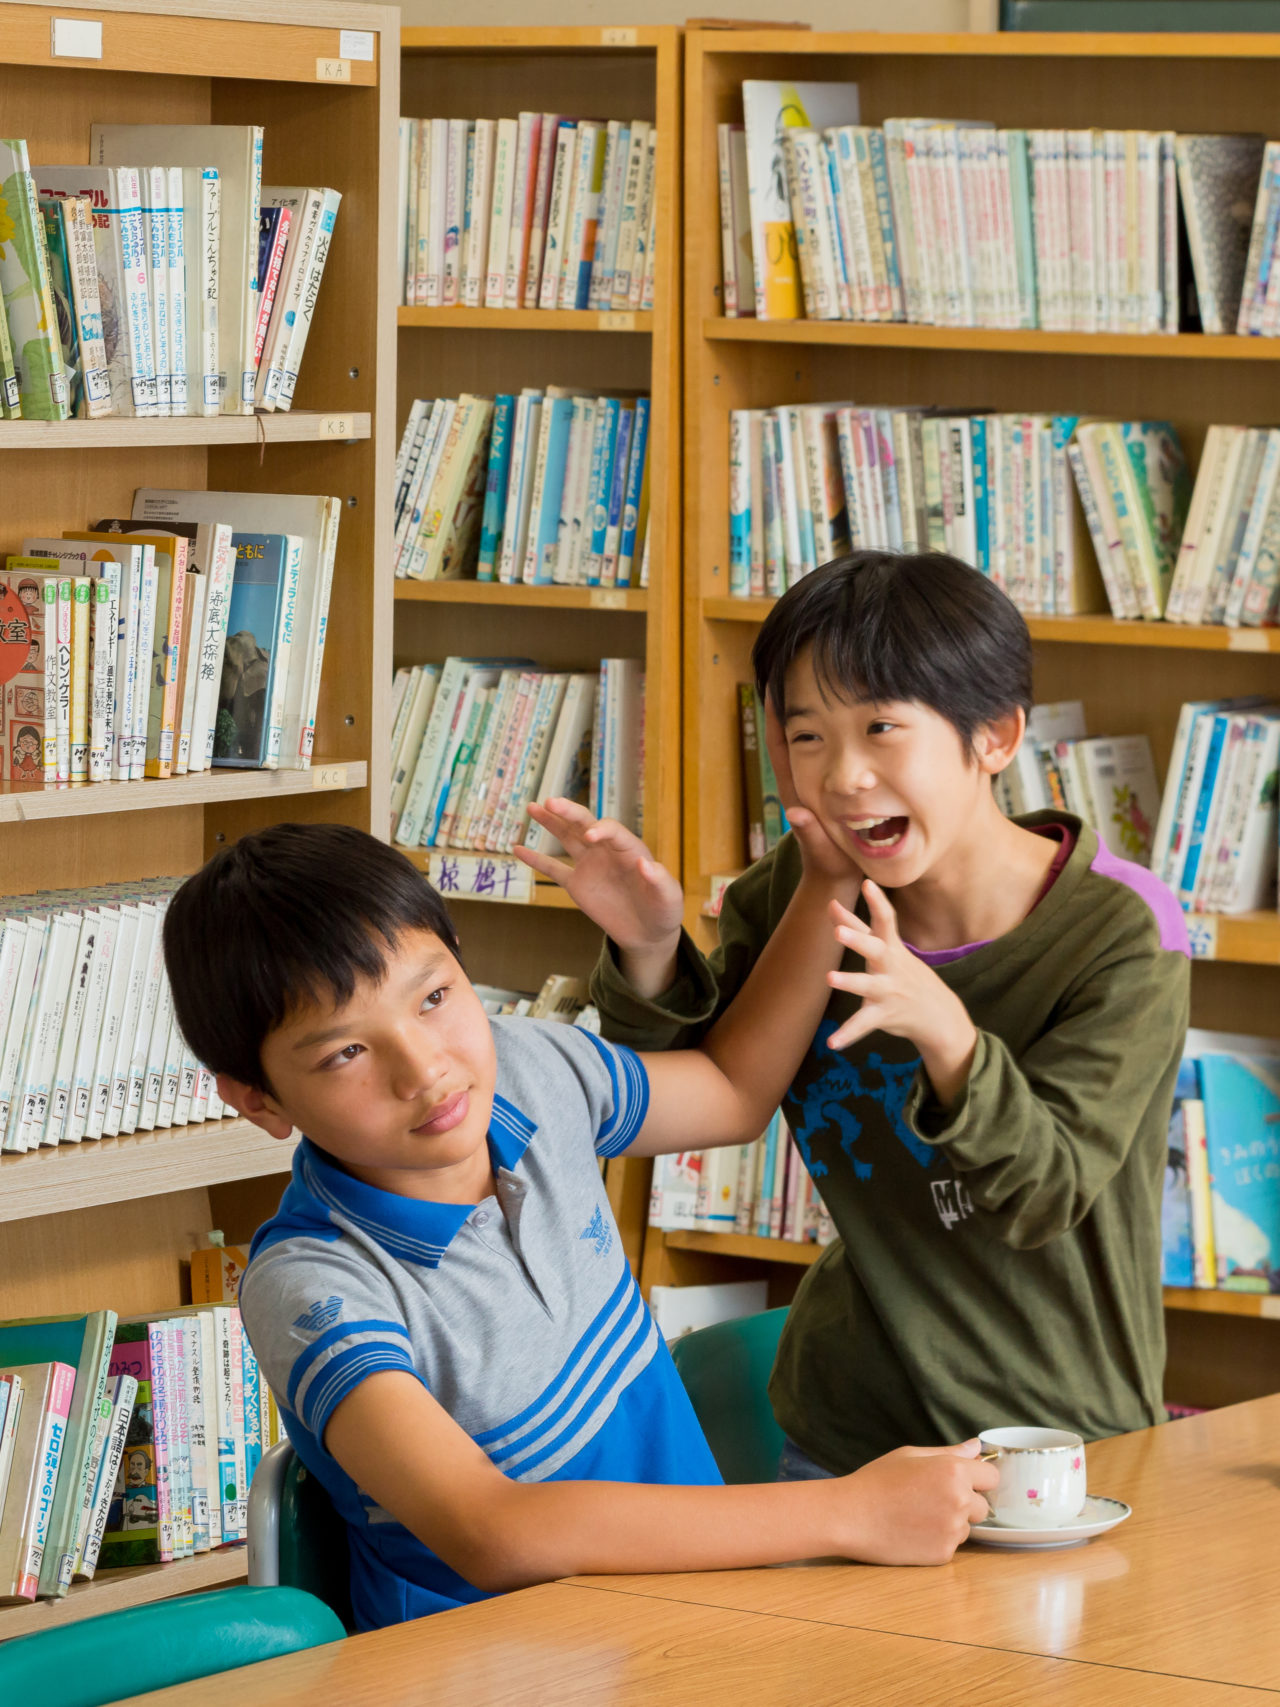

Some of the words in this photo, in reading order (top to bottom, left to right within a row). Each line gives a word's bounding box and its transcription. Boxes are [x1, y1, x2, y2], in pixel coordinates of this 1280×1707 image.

[137, 272, 146, 284] 6
[200, 590, 223, 681] 海底大探検
[46, 655, 57, 720] 作文教室
[58, 645, 71, 721] ヘレン・ケラー
[36, 1421, 64, 1545] セロ弾きのゴーシュ
